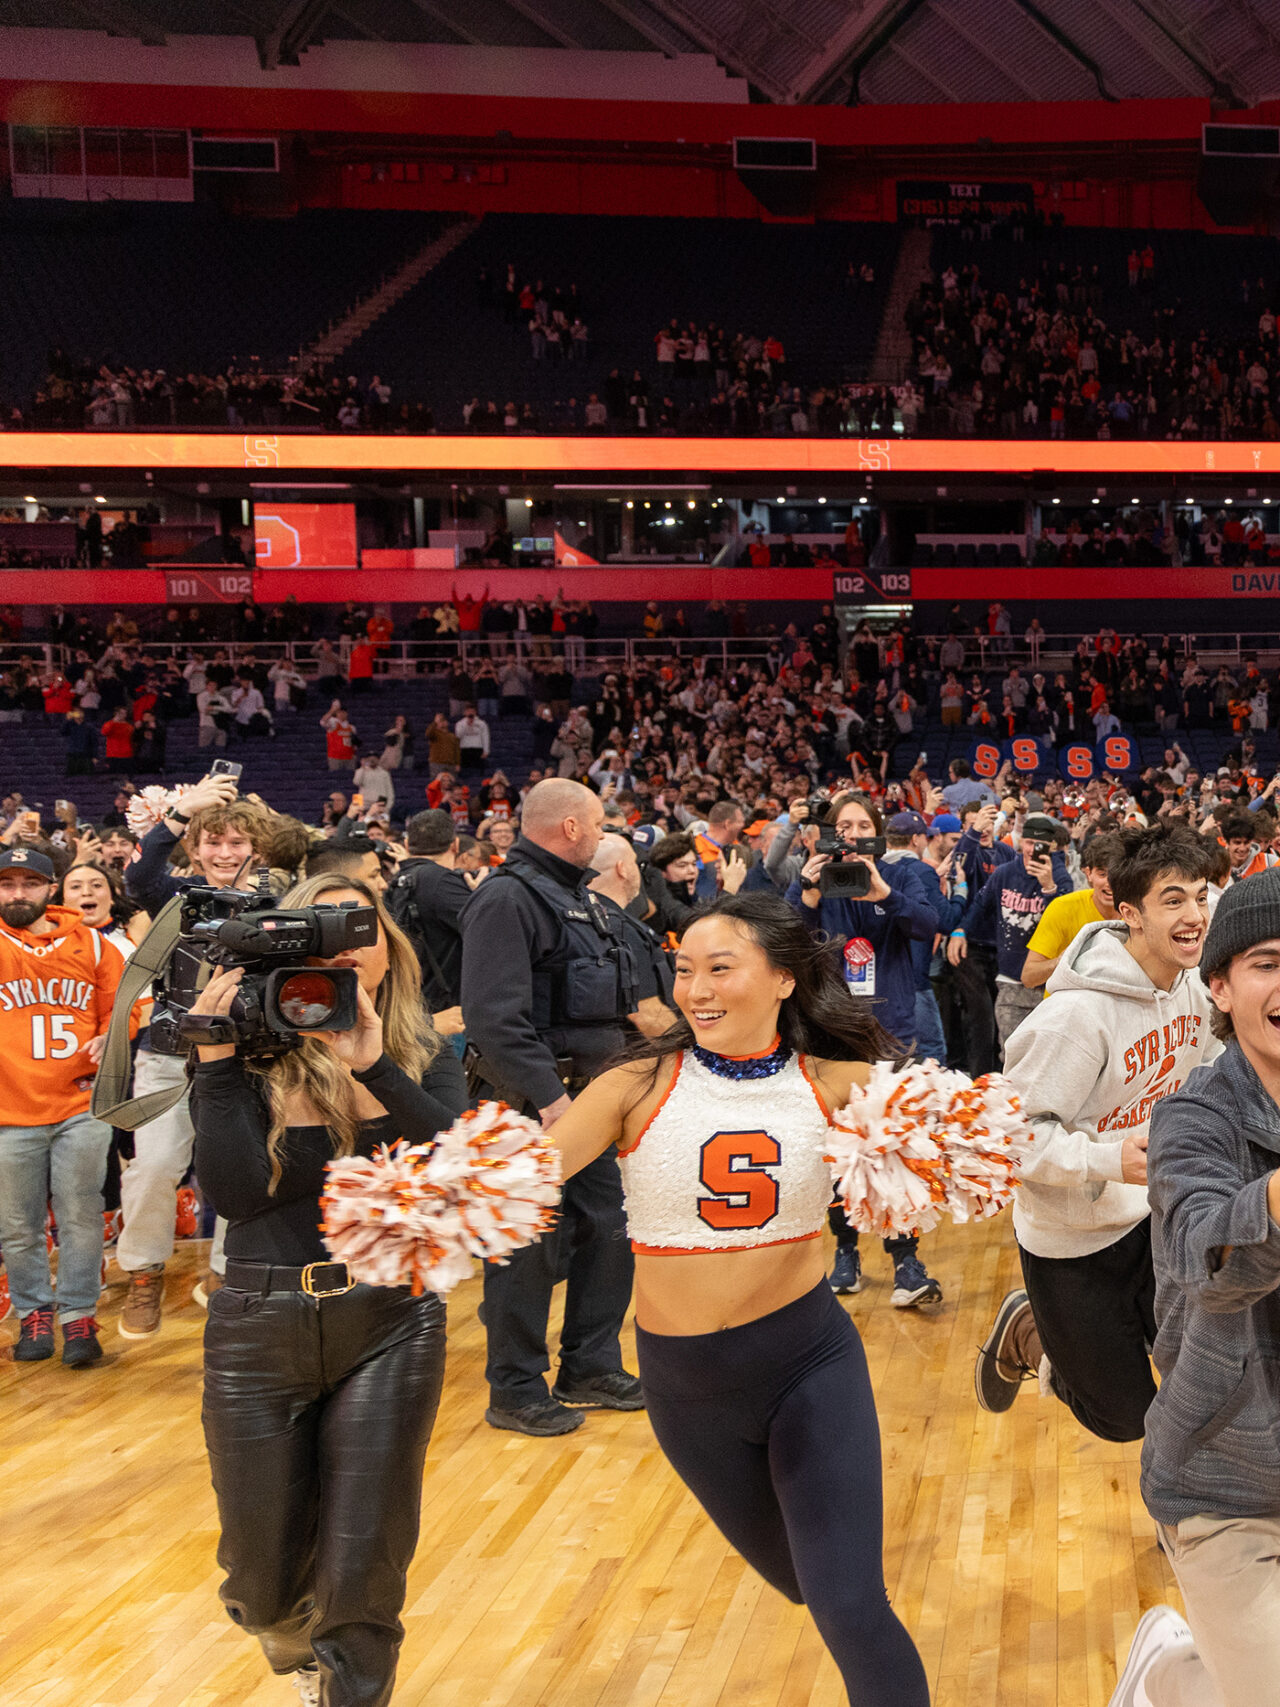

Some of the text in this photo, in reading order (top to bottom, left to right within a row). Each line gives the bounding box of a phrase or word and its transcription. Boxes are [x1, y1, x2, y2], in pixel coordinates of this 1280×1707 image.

[949, 184, 981, 197] TEXT
[170, 580, 198, 596] 101
[219, 577, 251, 593] 102
[834, 577, 865, 593] 102
[880, 574, 910, 591] 103
[974, 743, 1000, 778] S
[1012, 738, 1039, 770] S
[1067, 746, 1093, 778] S
[1105, 737, 1131, 769] S
[0, 977, 94, 1011] SYRACUSE
[31, 1013, 79, 1060] 15
[697, 1129, 781, 1231] S
